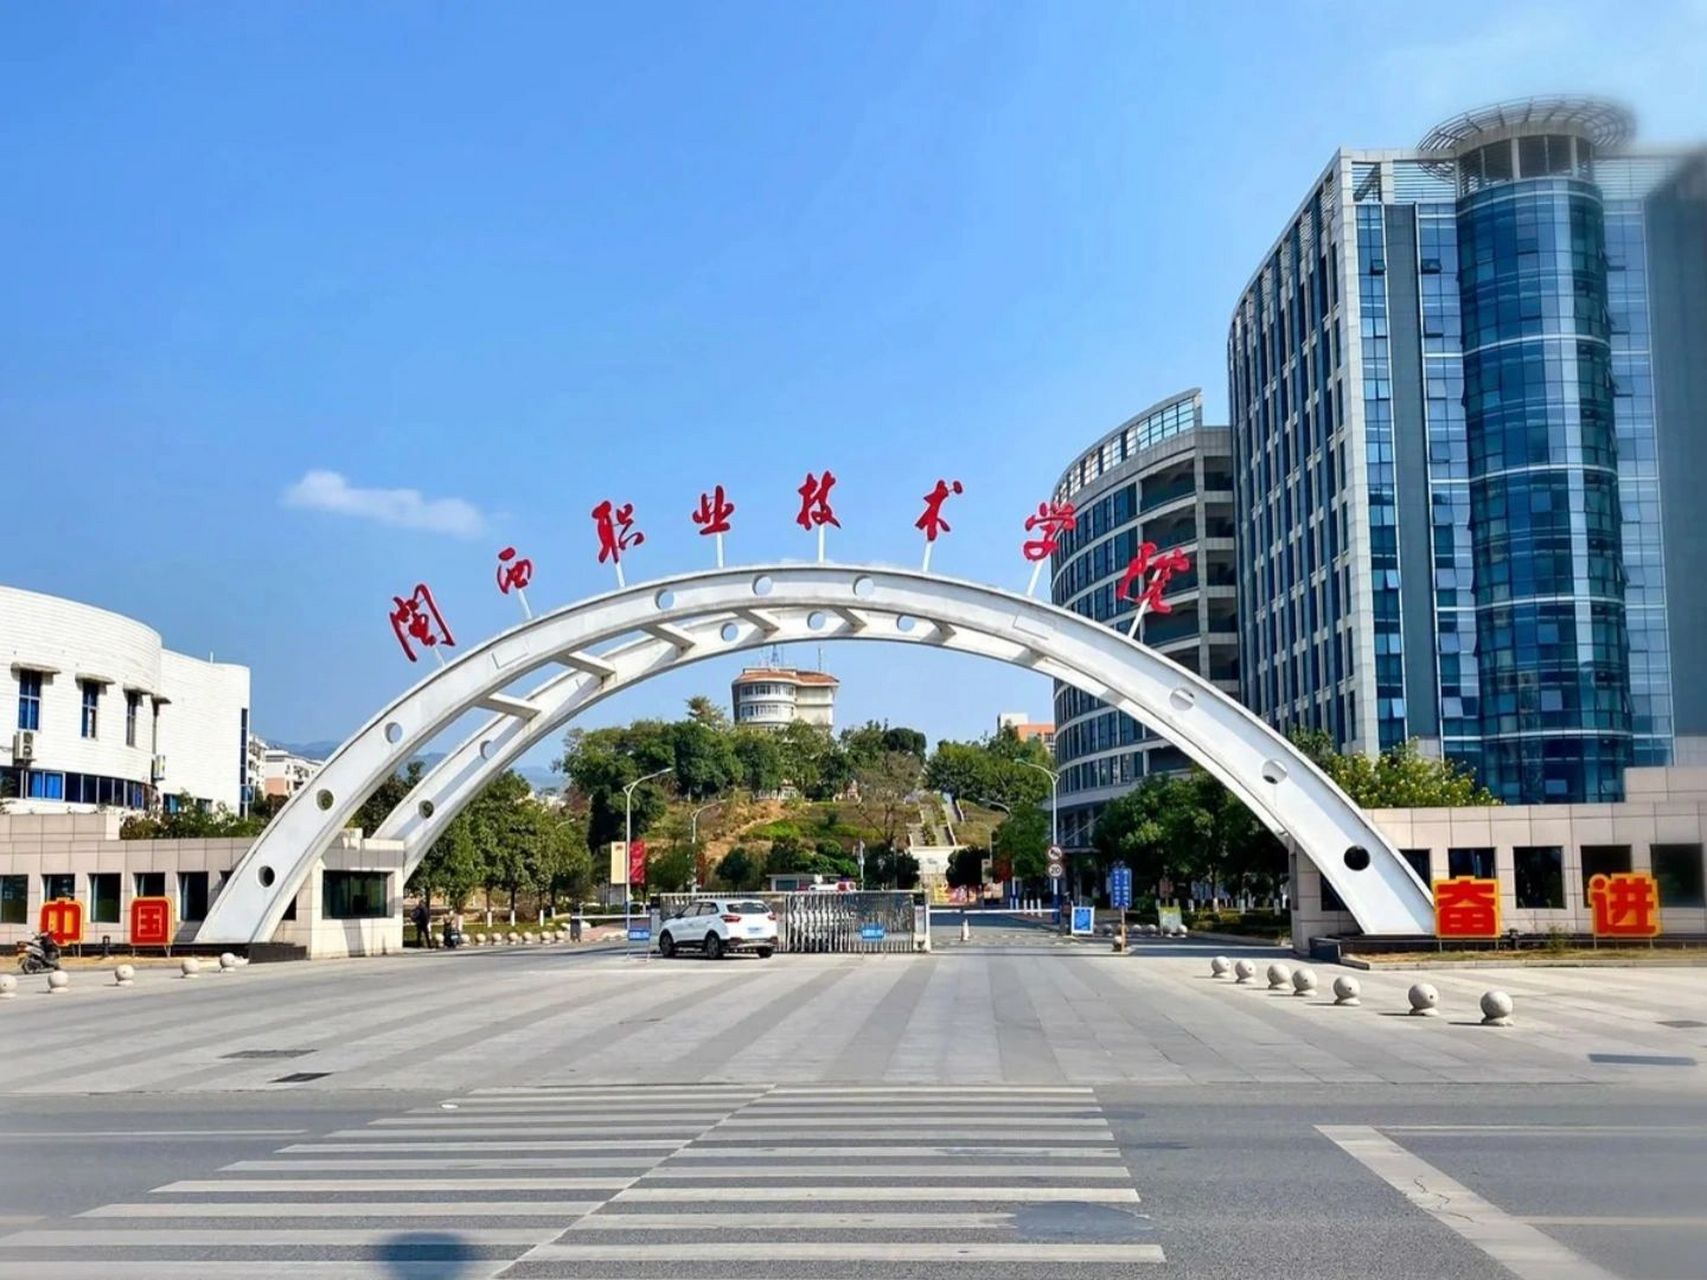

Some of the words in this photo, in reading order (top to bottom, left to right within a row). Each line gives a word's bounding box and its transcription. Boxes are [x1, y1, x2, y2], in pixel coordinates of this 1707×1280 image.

[389, 470, 1191, 663] 闽西职业技术学院
